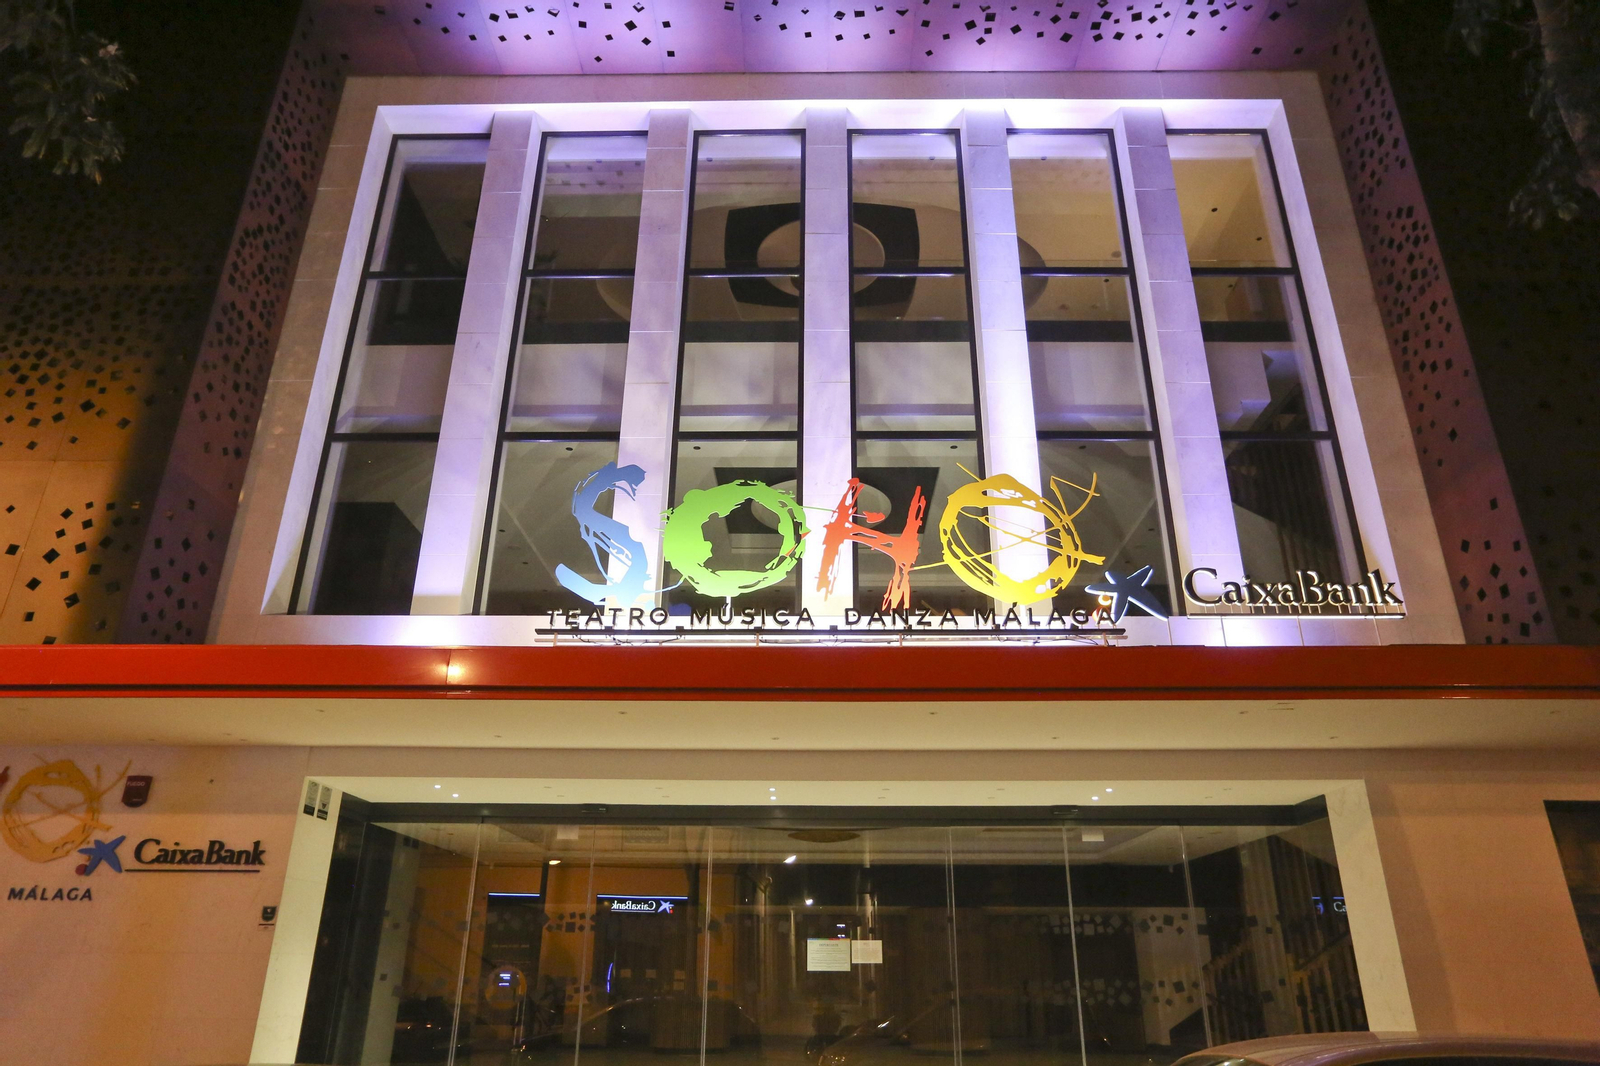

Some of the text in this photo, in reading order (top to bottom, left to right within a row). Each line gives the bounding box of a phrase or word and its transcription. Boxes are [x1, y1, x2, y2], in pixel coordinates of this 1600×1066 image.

[1182, 567, 1404, 607] CaixaBank
[547, 601, 1116, 627] TEATRO MÚSICA DANZA MÁLAGA
[134, 838, 266, 867] CaixaBank
[7, 884, 93, 902] MÁLAGA
